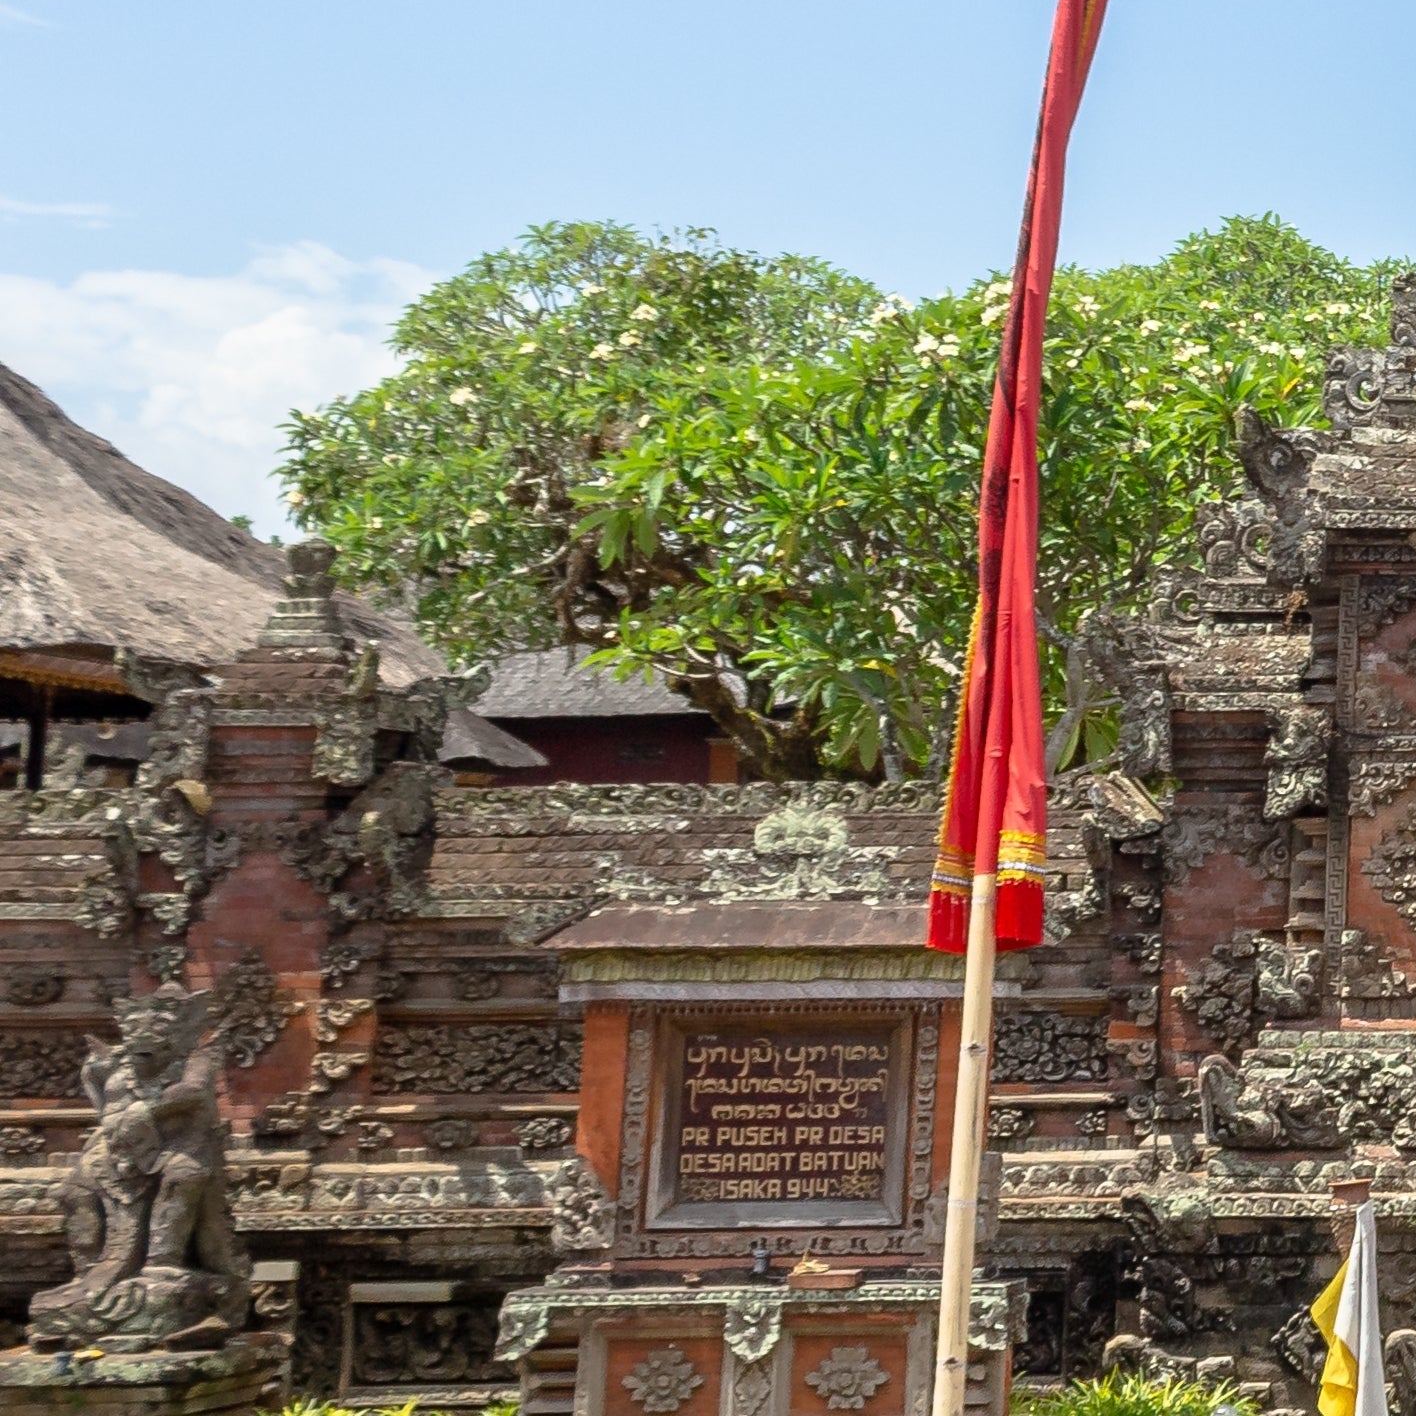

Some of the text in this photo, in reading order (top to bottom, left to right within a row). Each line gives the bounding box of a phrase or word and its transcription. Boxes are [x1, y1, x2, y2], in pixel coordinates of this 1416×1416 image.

[682, 1125, 885, 1146] PR PUSEH PR DESA
[679, 1151, 885, 1174] DESA ADAT BATUAN
[720, 1177, 829, 1200] ISAKA 944
